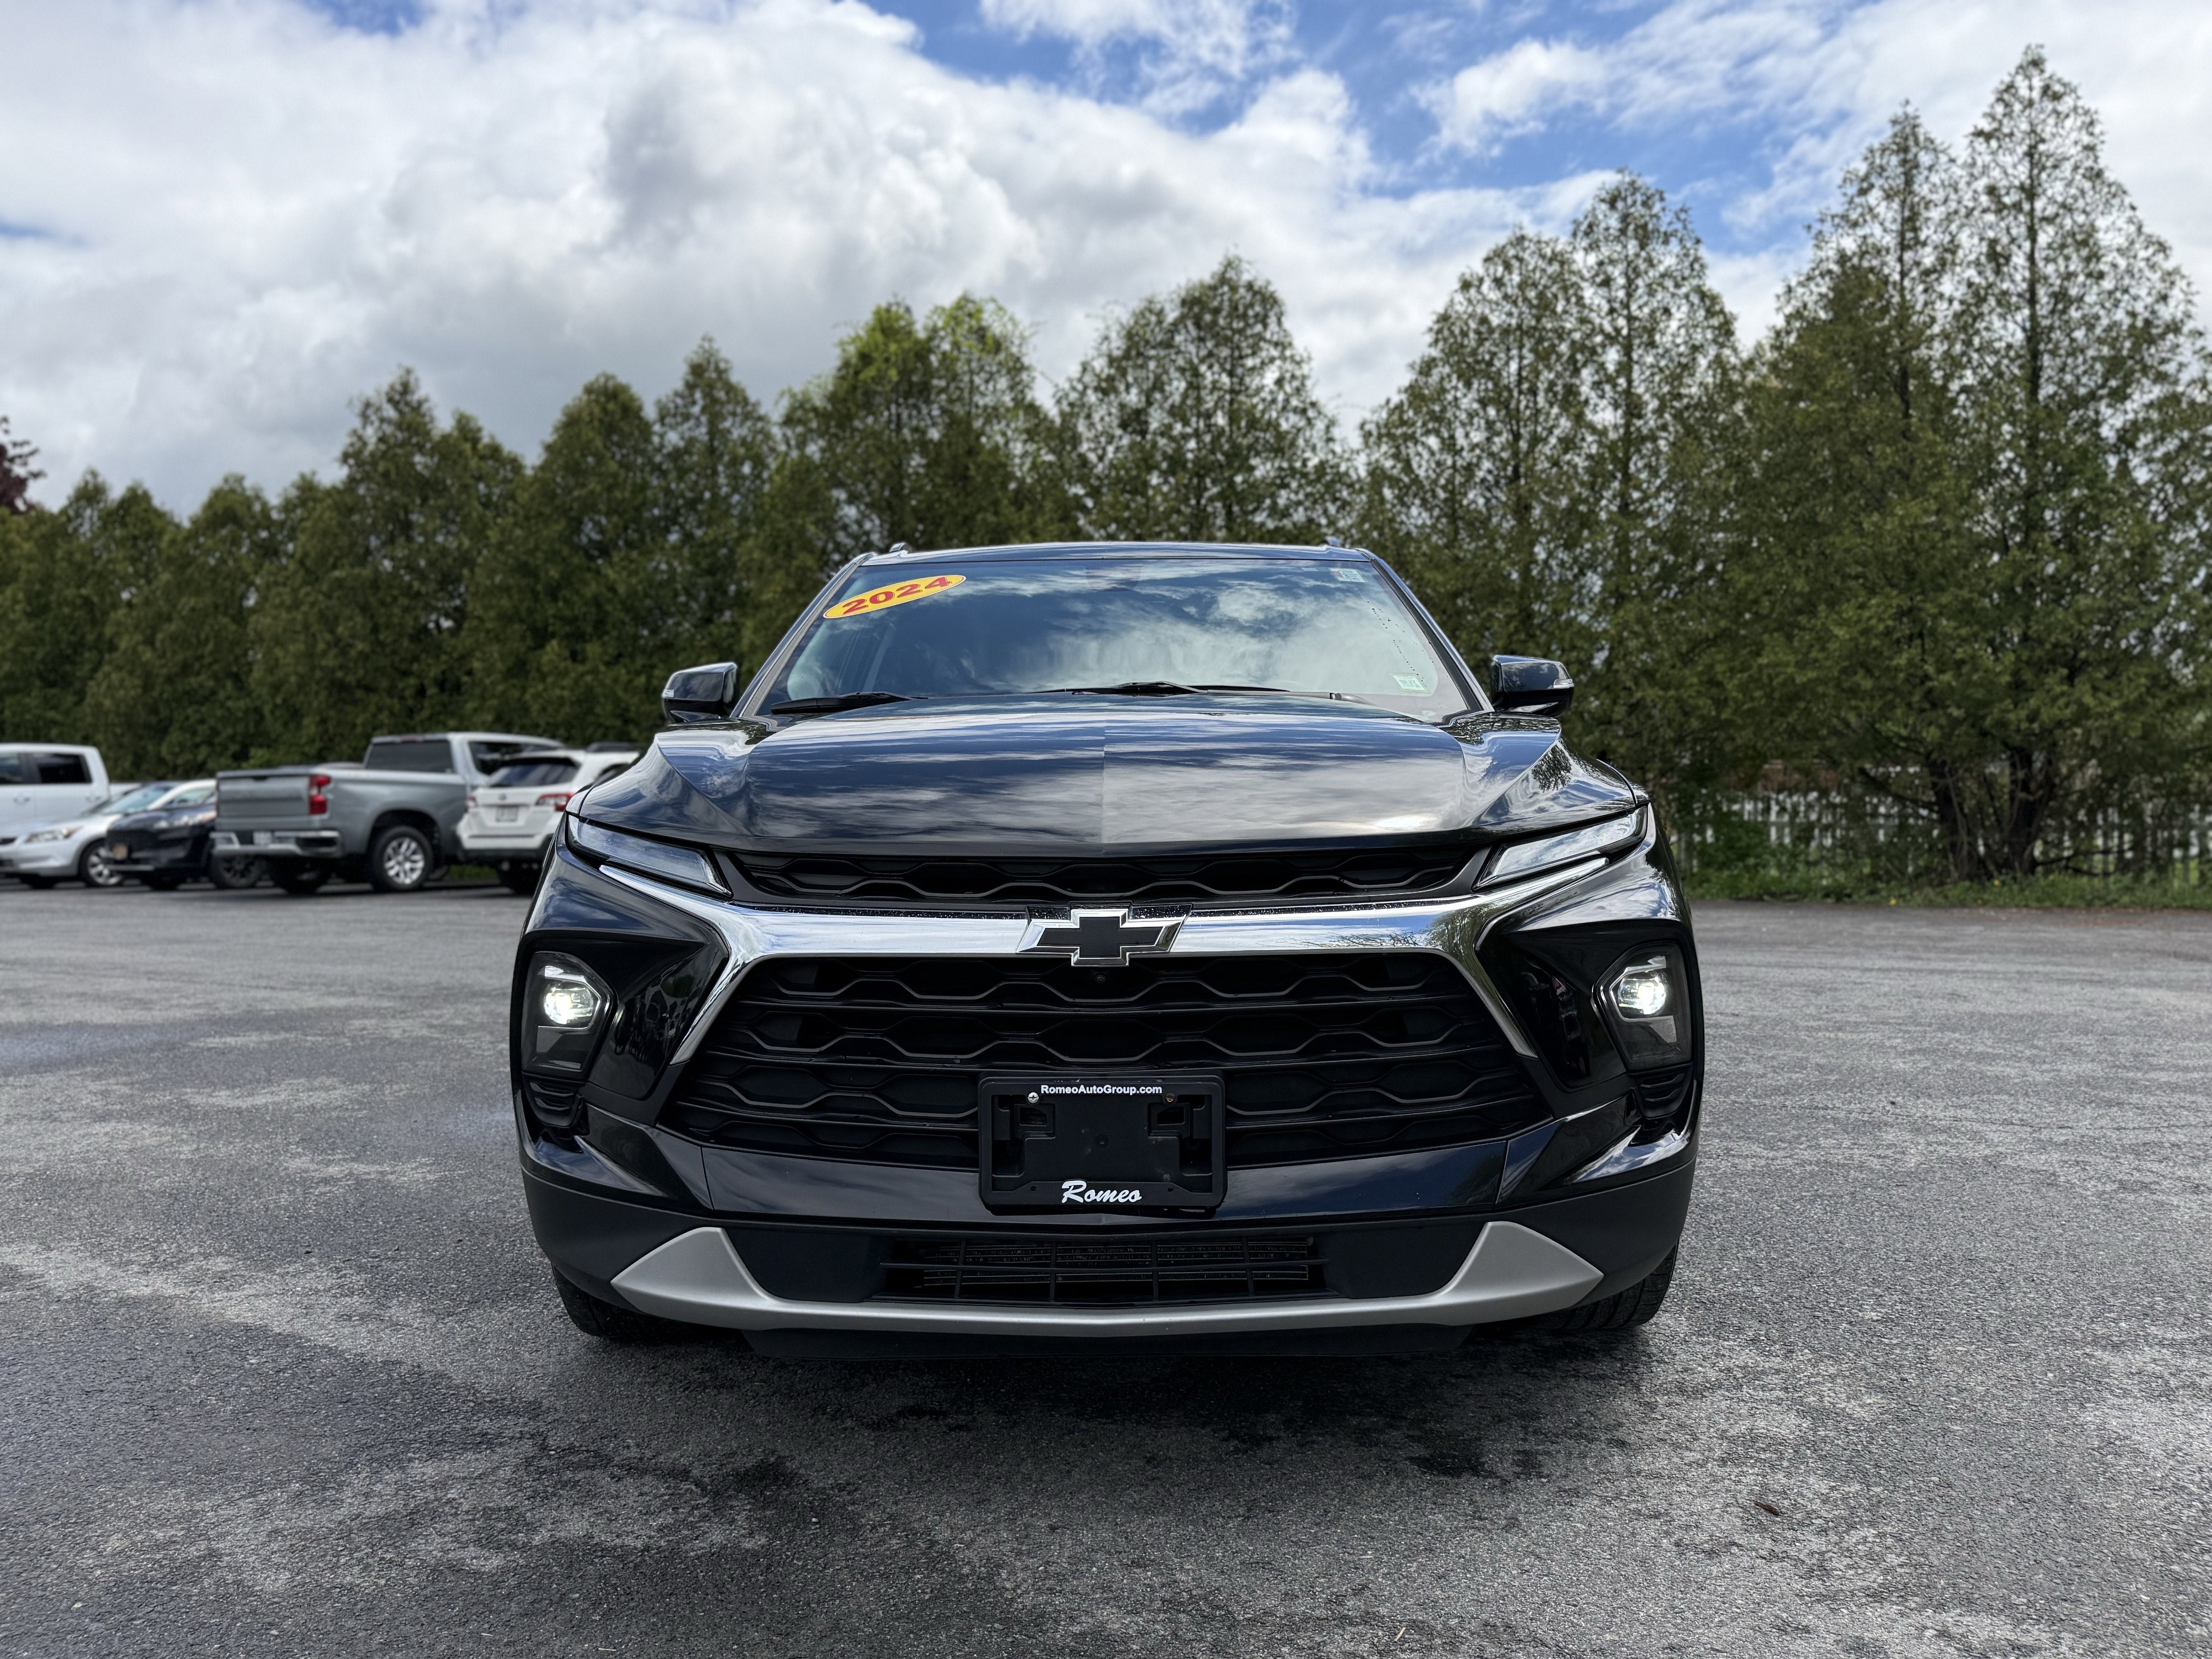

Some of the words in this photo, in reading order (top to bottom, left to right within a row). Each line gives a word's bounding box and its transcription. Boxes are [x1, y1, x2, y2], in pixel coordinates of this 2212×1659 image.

[842, 577, 950, 615] 2024
[1041, 1084, 1162, 1096] RomeoAutoGroup.com
[1061, 1180, 1142, 1203] Romeo
